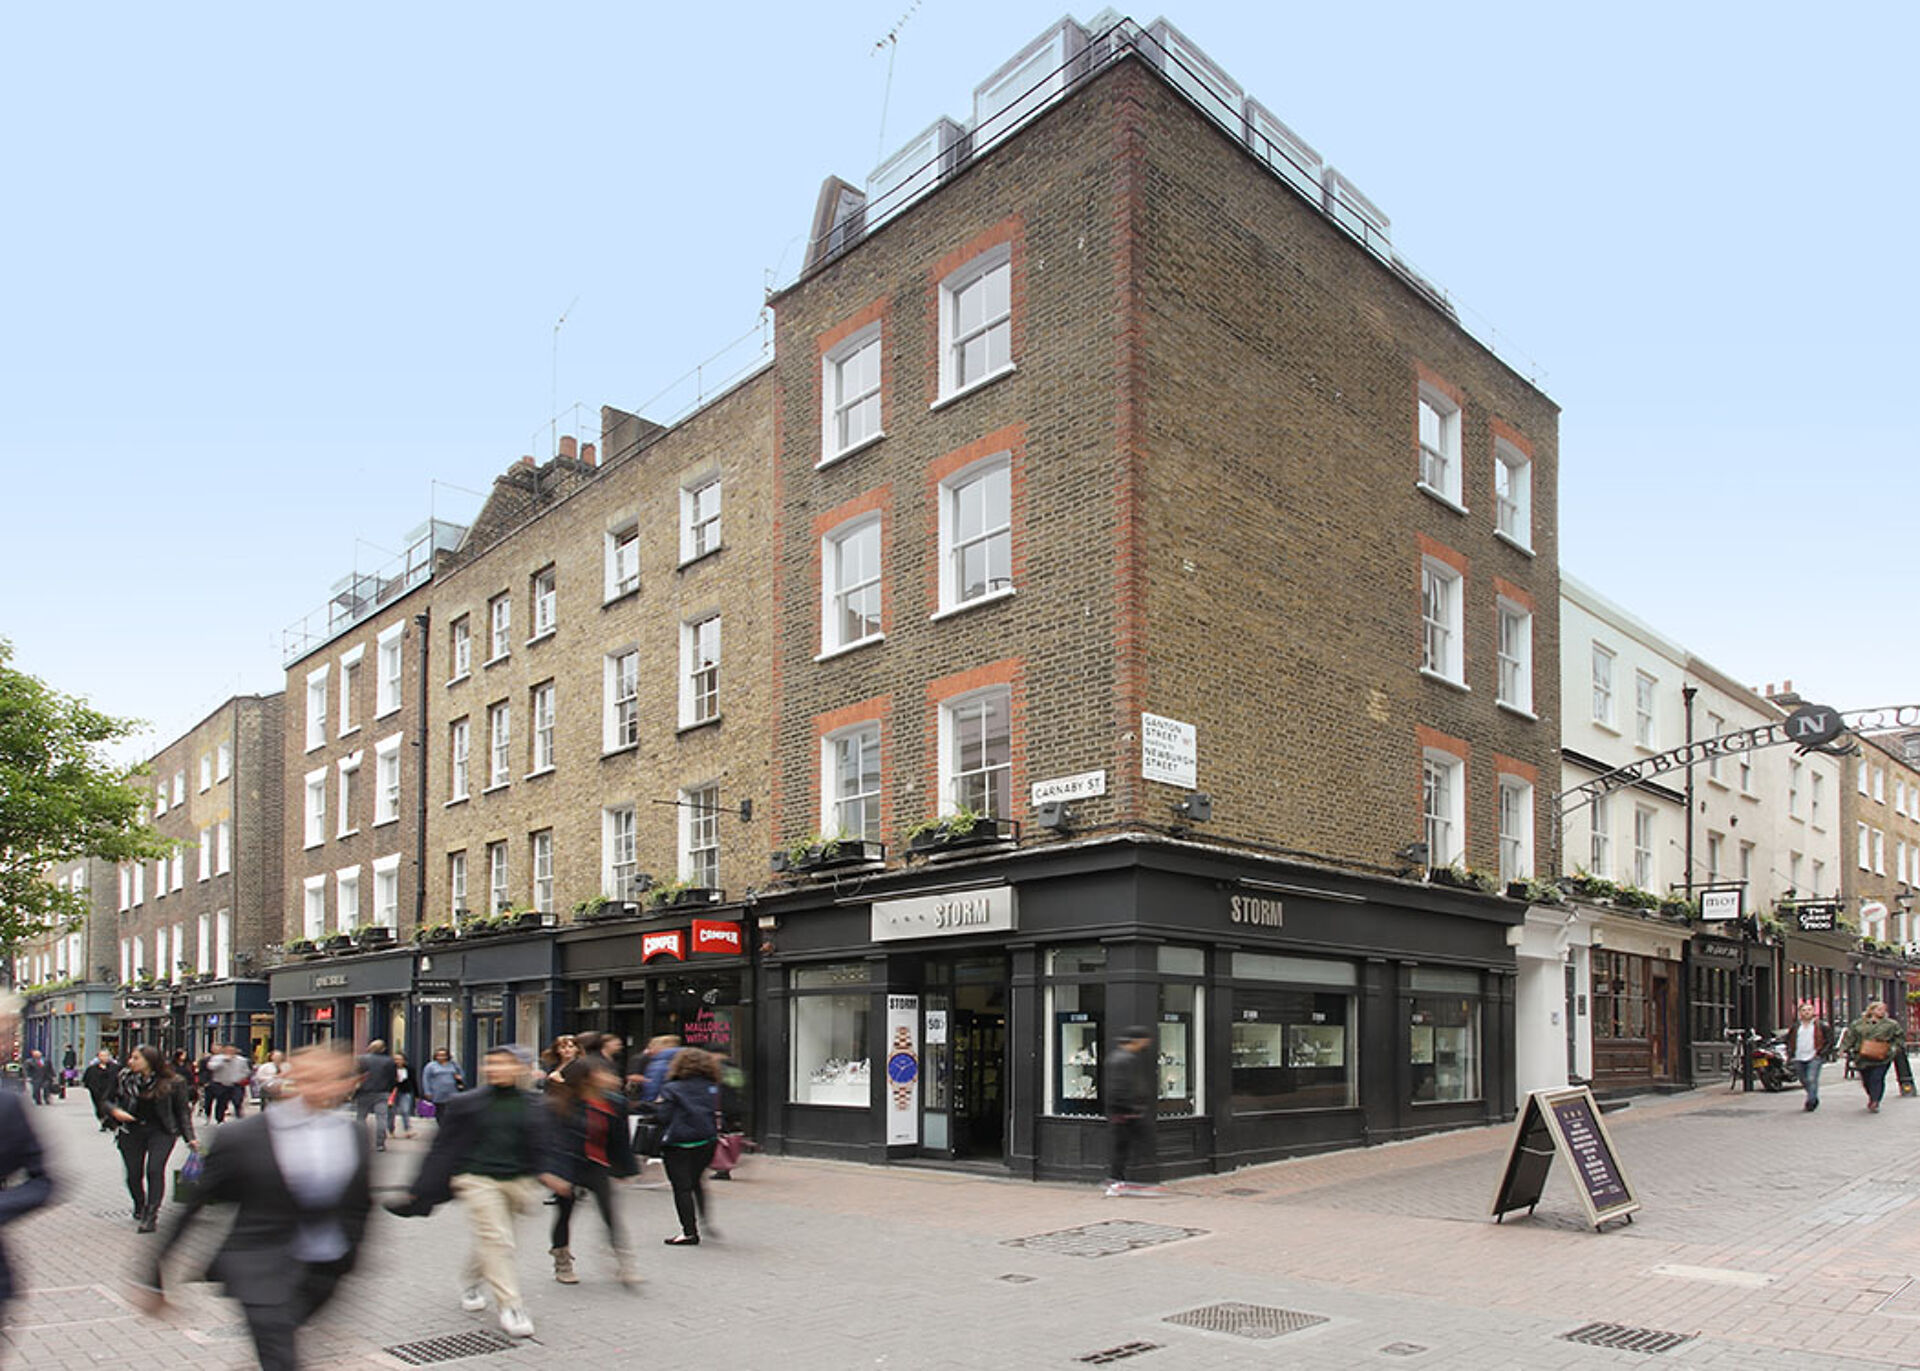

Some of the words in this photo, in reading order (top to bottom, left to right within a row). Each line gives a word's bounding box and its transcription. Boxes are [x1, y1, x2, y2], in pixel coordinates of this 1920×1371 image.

[1144, 716, 1182, 733] GANTON
[1796, 713, 1828, 736] N
[1146, 727, 1178, 742] STREET
[1144, 747, 1195, 765] NEWBURGH
[1146, 757, 1178, 771] STREET
[1579, 723, 1777, 804] NEWBURGH
[1035, 782, 1083, 800] CARNABY
[1088, 777, 1102, 791] ST
[934, 898, 990, 929] STORM
[1231, 894, 1283, 928] STORM
[700, 929, 738, 945] CAMPER
[890, 997, 917, 1010] STORM
